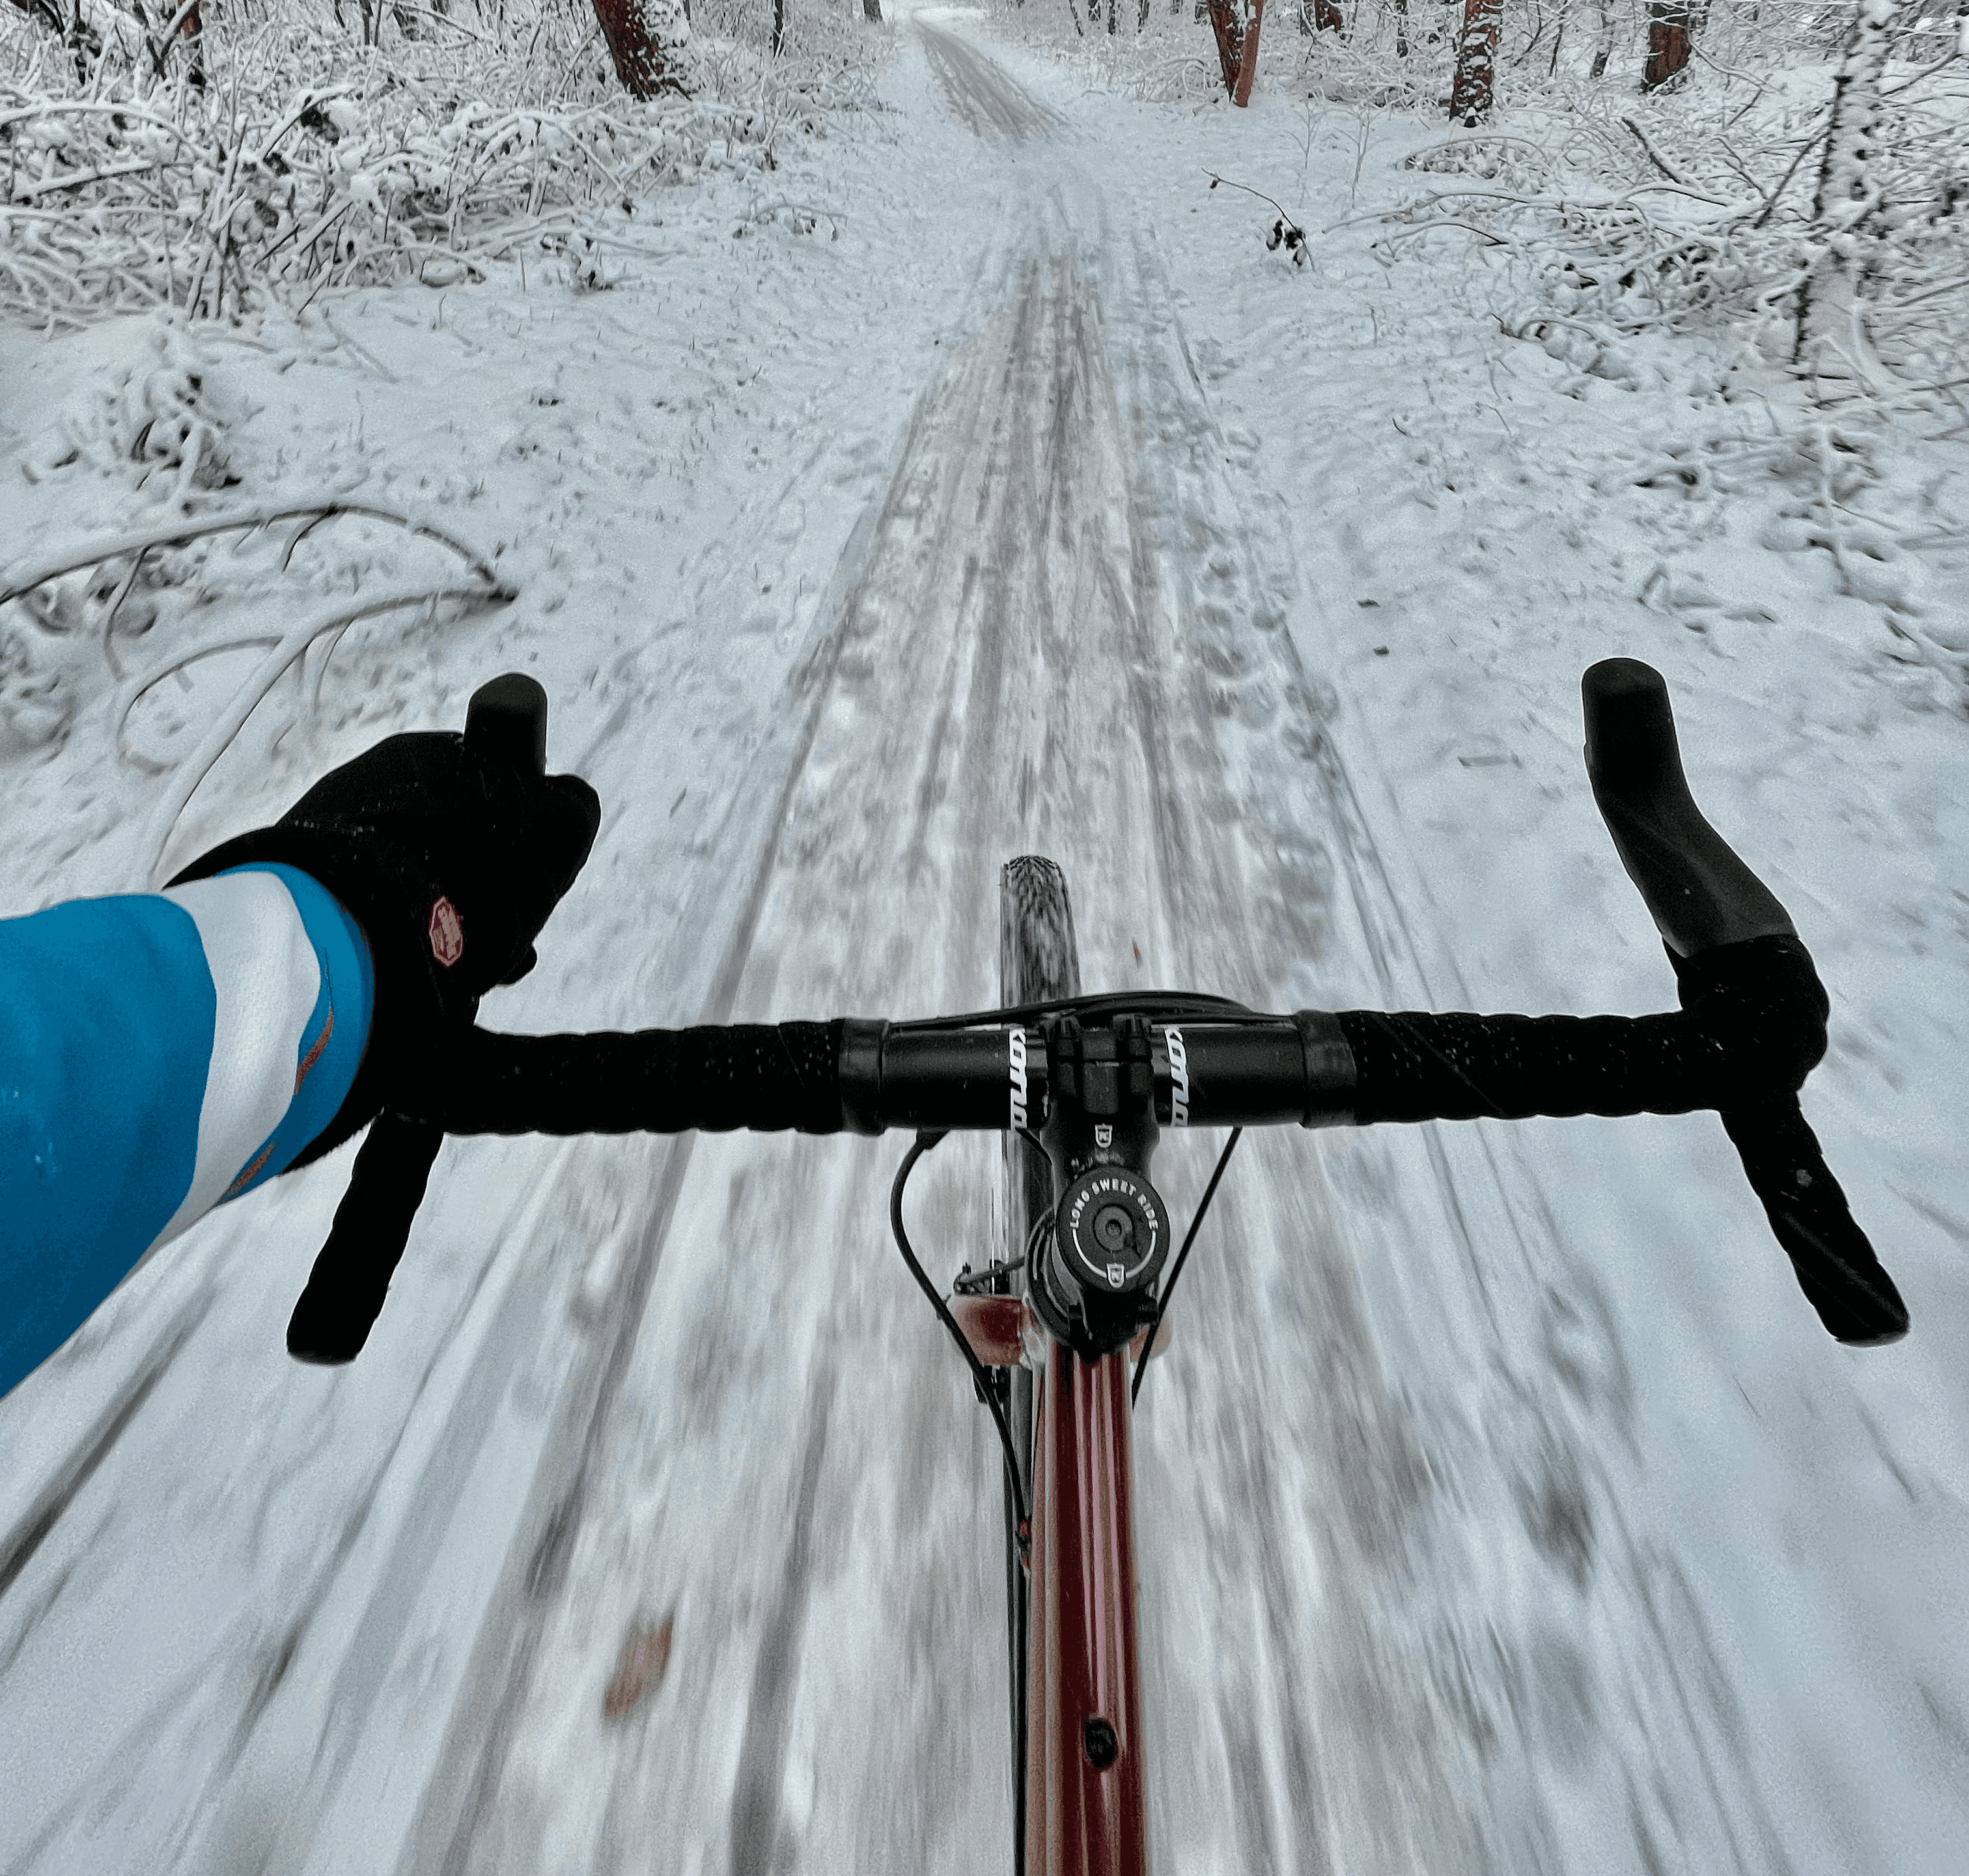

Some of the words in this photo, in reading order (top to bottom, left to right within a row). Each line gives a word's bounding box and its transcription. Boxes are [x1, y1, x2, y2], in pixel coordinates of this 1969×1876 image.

[1070, 1190, 1090, 1229] LONG
[1091, 1178, 1137, 1196] SWEET
[1138, 1193, 1158, 1229] RIDE
